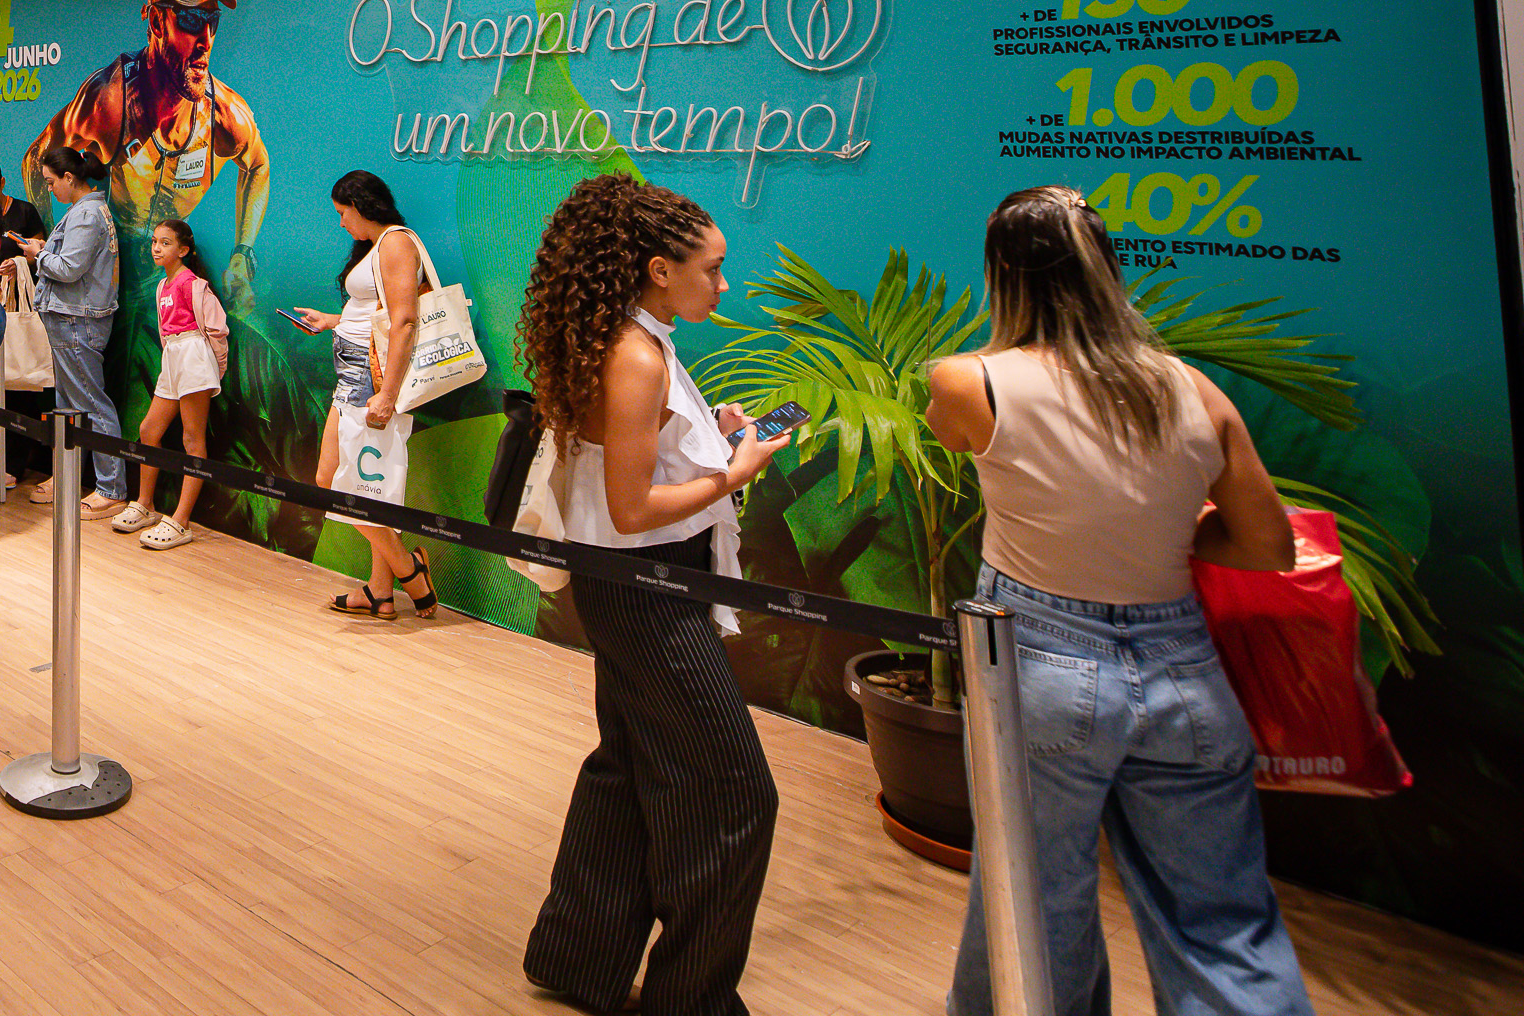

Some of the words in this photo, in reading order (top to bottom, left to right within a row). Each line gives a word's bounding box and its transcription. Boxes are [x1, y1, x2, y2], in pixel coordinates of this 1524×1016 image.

[1033, 8, 1058, 23] DE
[993, 20, 1134, 41] PROFISSIONAIS
[1138, 14, 1274, 35] ENVOLVIDOS
[993, 38, 1112, 56] SEGURANÇA,
[1115, 33, 1219, 51] TRÂNSITO
[1224, 32, 1236, 46] E
[1241, 28, 1342, 45] LIMPEZA
[3, 42, 62, 70] JUNHO
[1040, 114, 1064, 127] DE
[1055, 59, 1300, 127] 1.000
[393, 111, 474, 154] um
[482, 106, 612, 154] novo
[624, 75, 872, 203] tempo!
[998, 131, 1065, 144] MUDAS
[1069, 131, 1154, 145] NATIVAS
[1158, 126, 1315, 145] DESTRIBUÍDAS
[999, 144, 1091, 159] AUMENTO
[1095, 145, 1125, 160] NO
[1129, 145, 1223, 161] IMPACTO
[1227, 146, 1362, 162] AMBIENTAL
[185, 159, 204, 171] LAURO
[1085, 171, 1263, 239] 40%
[1171, 239, 1287, 260] ESTIMADO
[1291, 246, 1341, 263] DAS
[1134, 253, 1178, 269] RUA
[421, 310, 447, 324] LAURO
[421, 524, 439, 533] Parque
[439, 527, 462, 540] Shopping
[520, 548, 540, 560] Parque
[540, 553, 567, 566] Shopping
[636, 574, 659, 586] Parque
[658, 579, 689, 592] Shopping
[767, 602, 794, 615] Parque
[793, 607, 828, 622] Shopping
[918, 633, 948, 646] Parque
